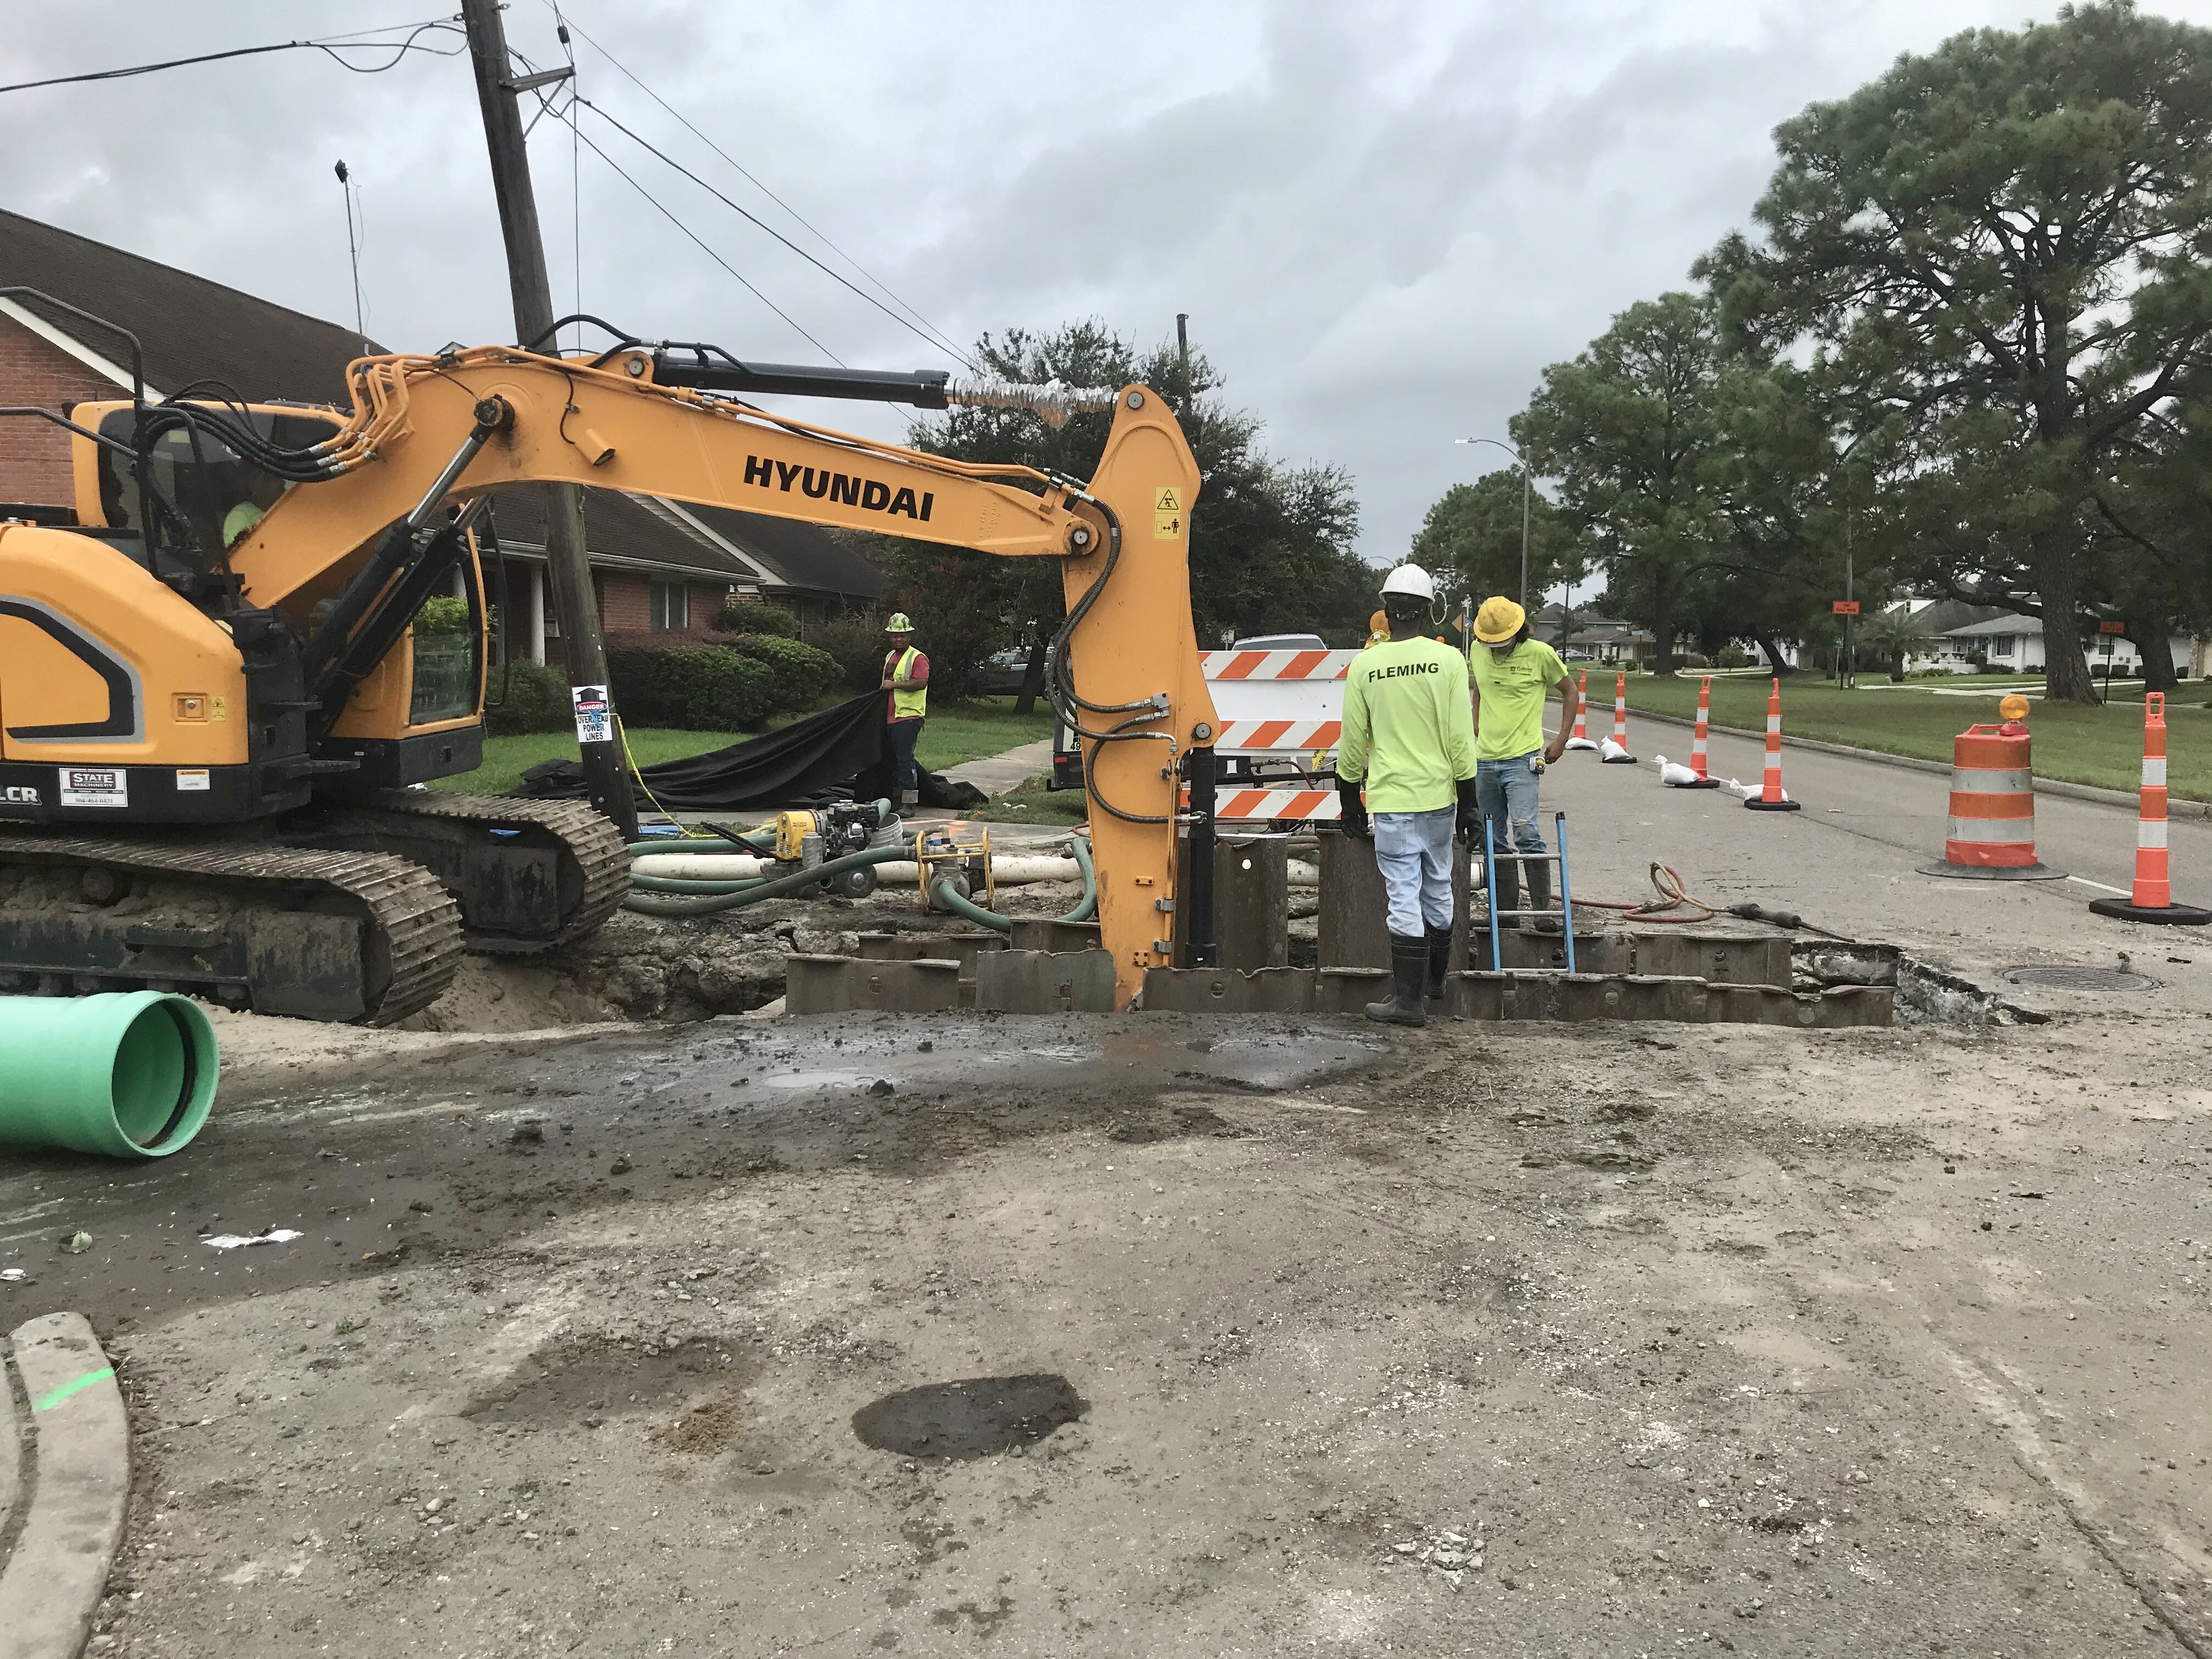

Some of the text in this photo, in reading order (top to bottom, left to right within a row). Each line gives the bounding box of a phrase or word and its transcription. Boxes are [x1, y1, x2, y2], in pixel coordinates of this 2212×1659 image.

[743, 455, 934, 522] HYUNDAI
[1368, 663, 1438, 683] FLEMING
[586, 732, 603, 741] LINES
[73, 773, 113, 783] STATE
